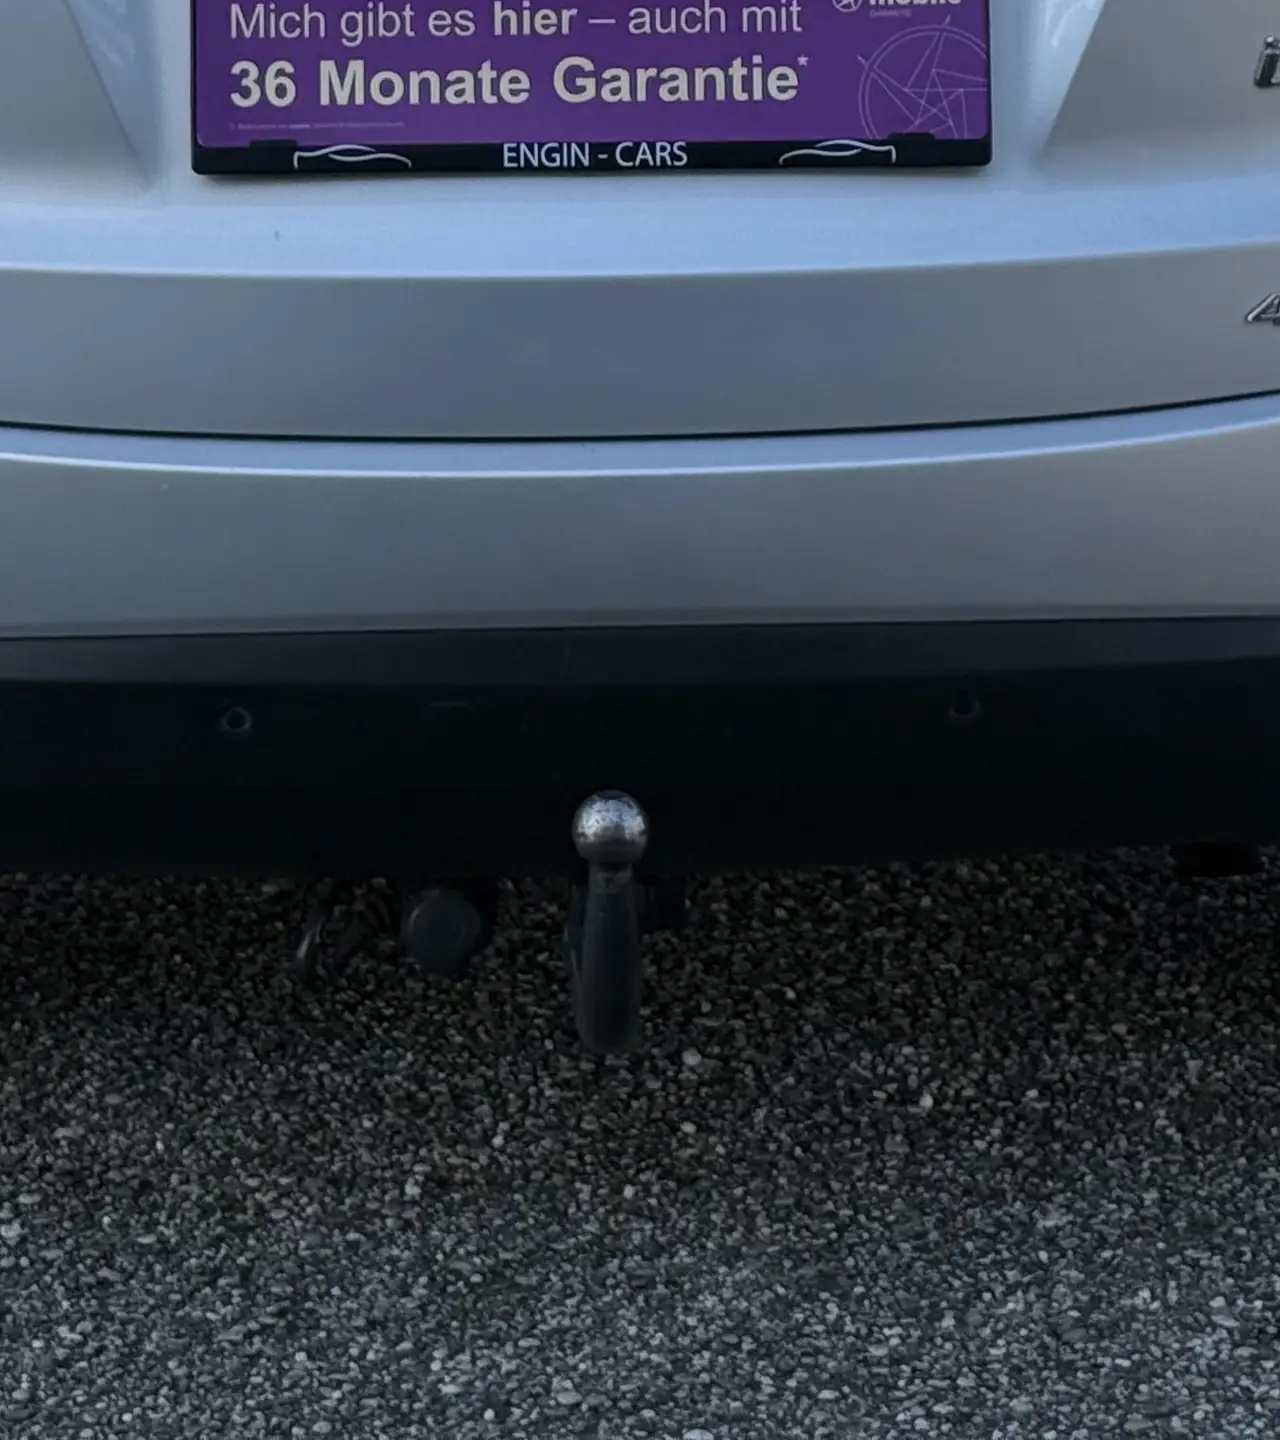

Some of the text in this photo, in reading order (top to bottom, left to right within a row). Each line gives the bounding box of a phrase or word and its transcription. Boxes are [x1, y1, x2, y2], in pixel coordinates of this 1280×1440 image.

[230, 2, 326, 40] Mich
[340, 1, 416, 48] gibt
[427, 8, 476, 37] es
[493, 0, 578, 37] hier
[229, 59, 297, 107] 36
[320, 58, 531, 107] Monate
[503, 141, 590, 168] ENGIN
[615, 141, 688, 167] CARS
